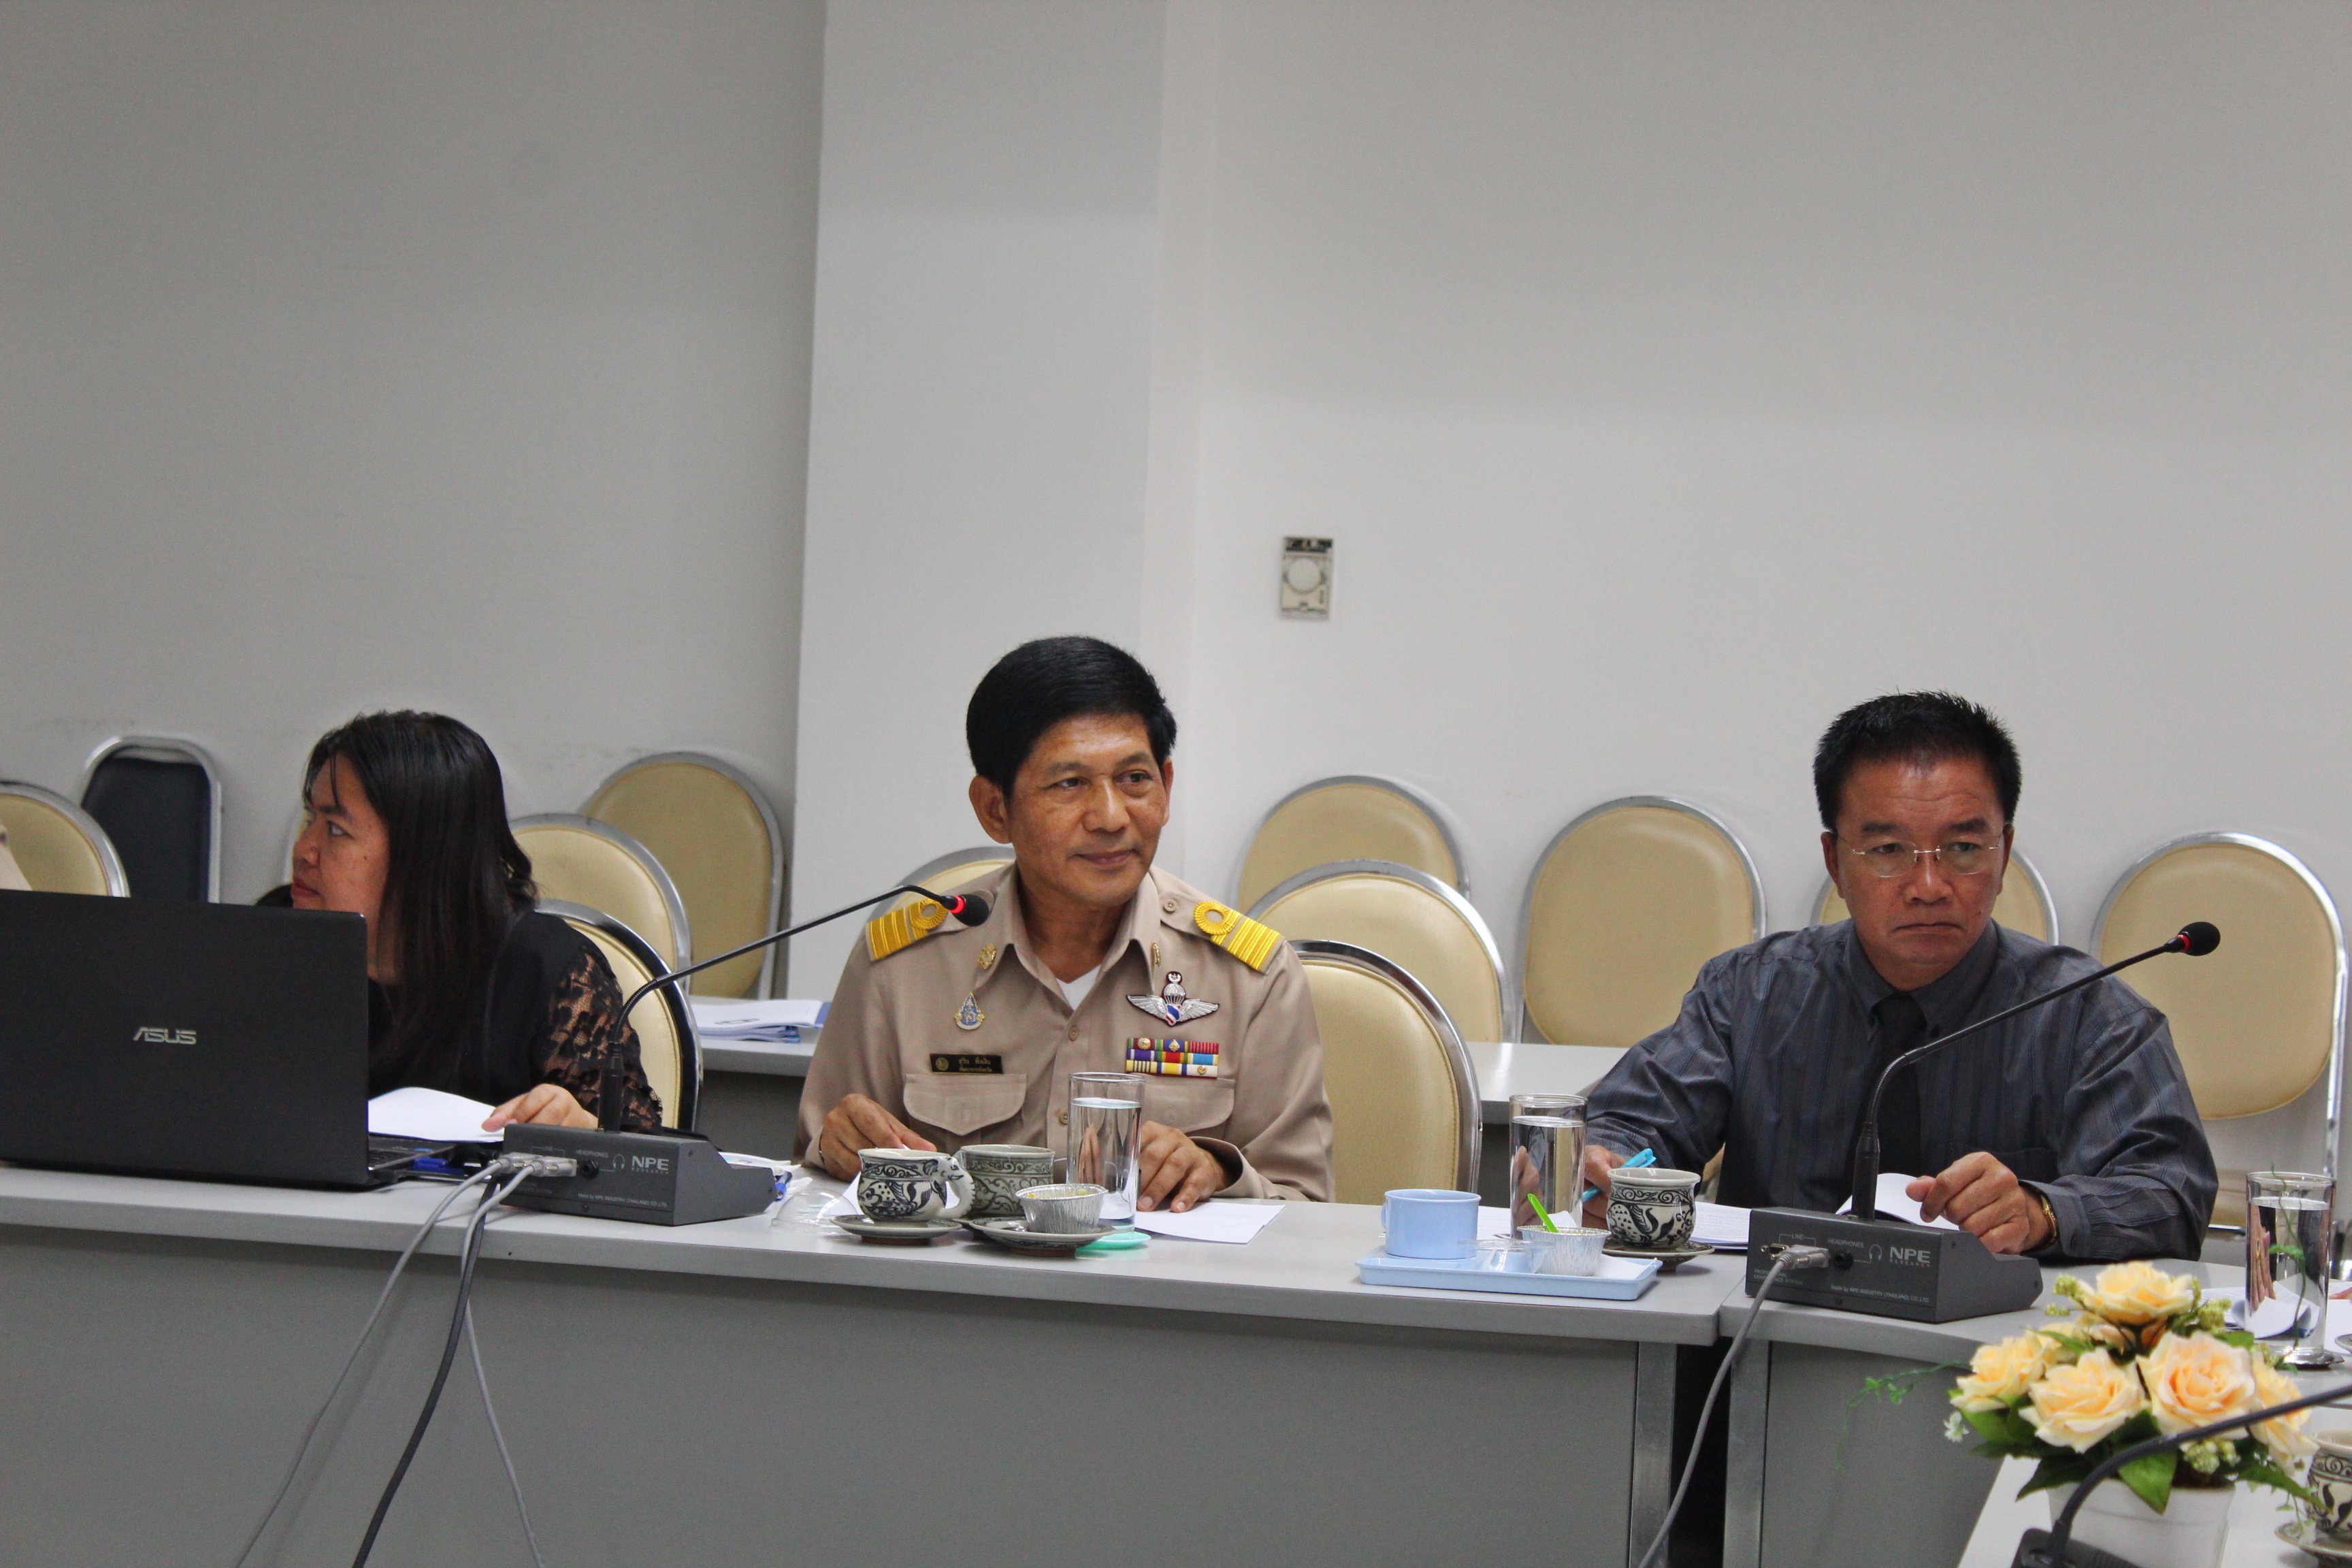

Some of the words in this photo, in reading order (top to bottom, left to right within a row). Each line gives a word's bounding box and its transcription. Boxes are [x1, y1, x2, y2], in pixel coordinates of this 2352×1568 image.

[133, 1026, 197, 1045] ASUS
[632, 1156, 670, 1171] NPE
[631, 1166, 669, 1175] RESEARCH
[1828, 1238, 1864, 1248] HEADPHONES
[1890, 1246, 1931, 1264] NPE
[1889, 1258, 1931, 1268] RESEARCH
[1860, 1288, 1882, 1296] INDUSTRY
[1884, 1292, 1910, 1301] (THAILAND)
